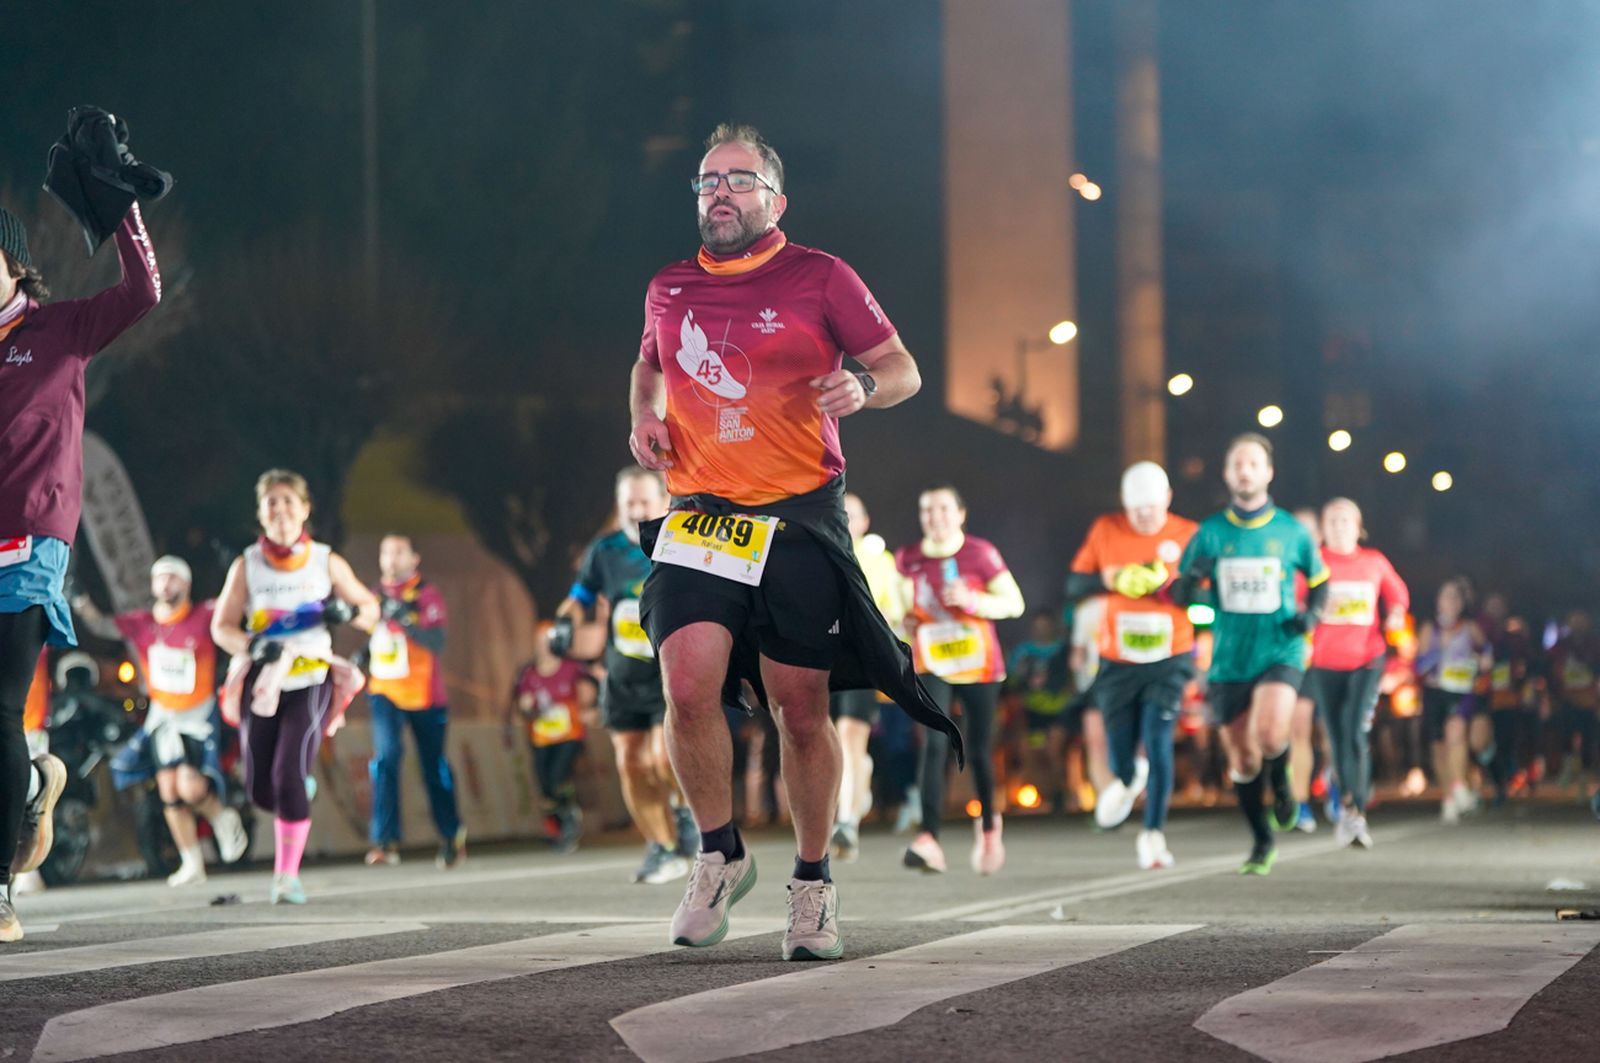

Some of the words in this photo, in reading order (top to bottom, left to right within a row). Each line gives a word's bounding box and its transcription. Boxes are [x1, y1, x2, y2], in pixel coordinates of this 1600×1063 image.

[696, 359, 721, 385] 43
[719, 418, 741, 430] SAN
[681, 513, 754, 548] 4089
